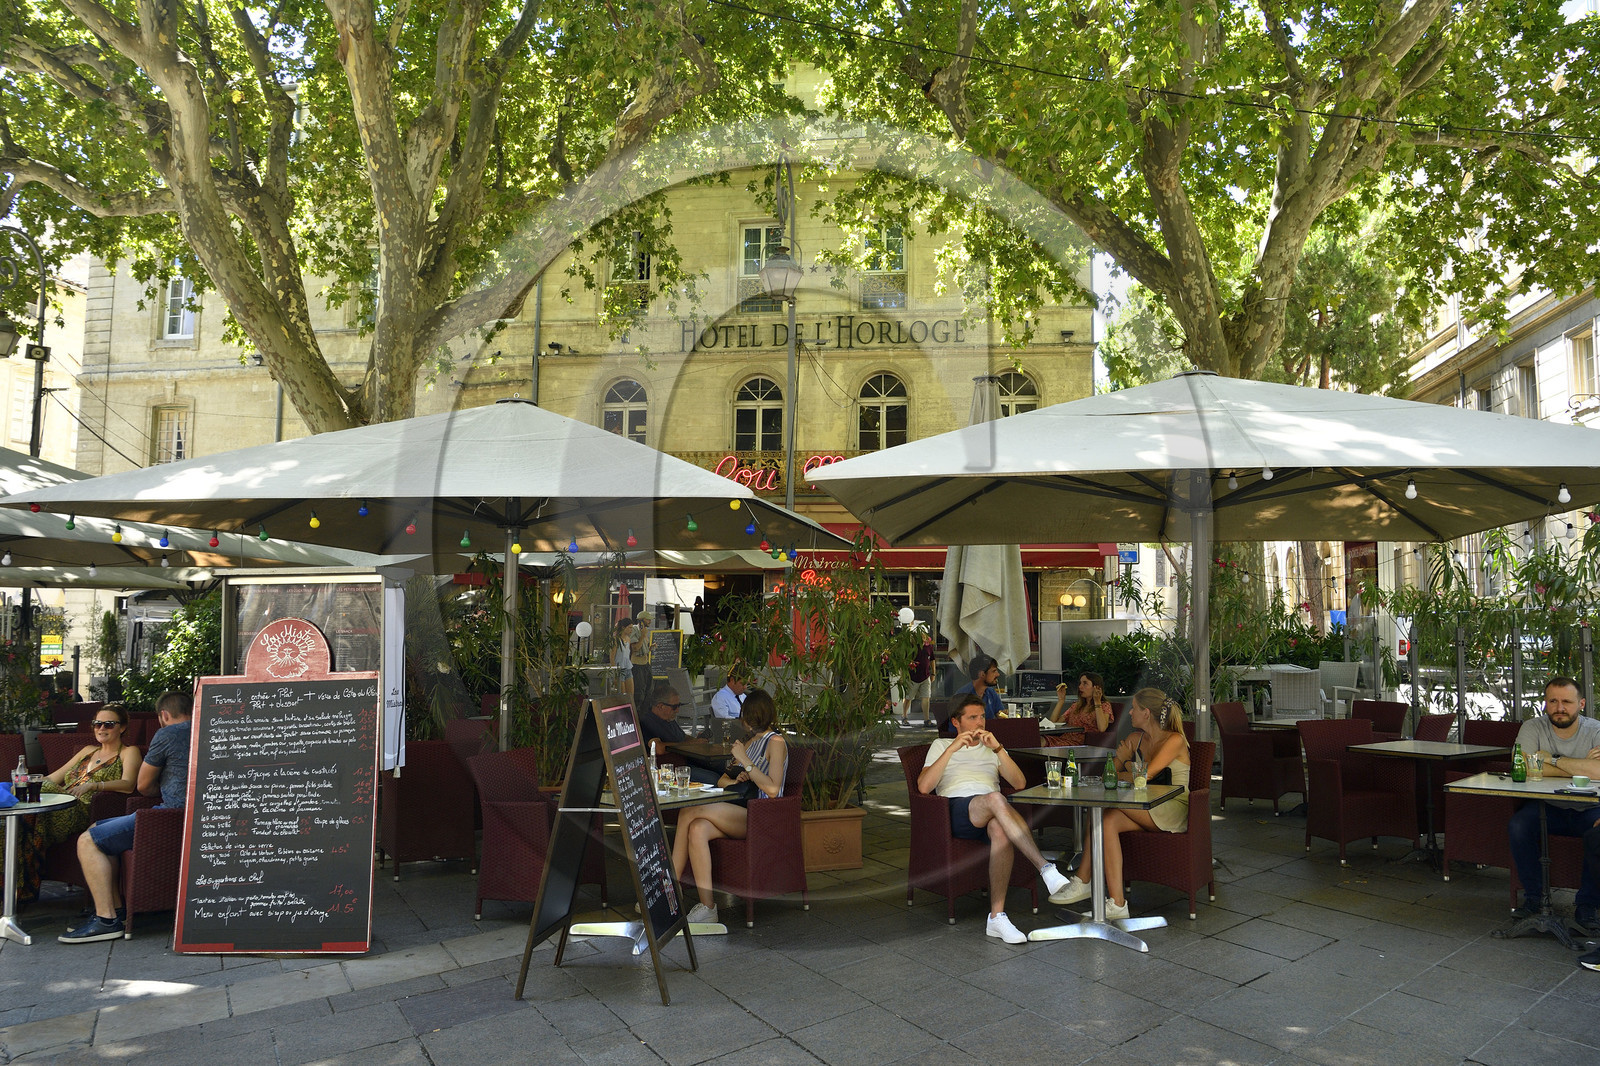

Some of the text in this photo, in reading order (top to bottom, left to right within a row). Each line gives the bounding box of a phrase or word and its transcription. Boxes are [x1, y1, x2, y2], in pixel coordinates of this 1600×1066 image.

[680, 315, 966, 352] HOTEL DE L'HORLOGE
[260, 633, 282, 653] Lou
[277, 687, 293, 698] Plat
[249, 699, 267, 710] Plat
[206, 770, 236, 784] Spaghetti
[194, 906, 214, 919] Menu
[217, 904, 248, 926] enfant
